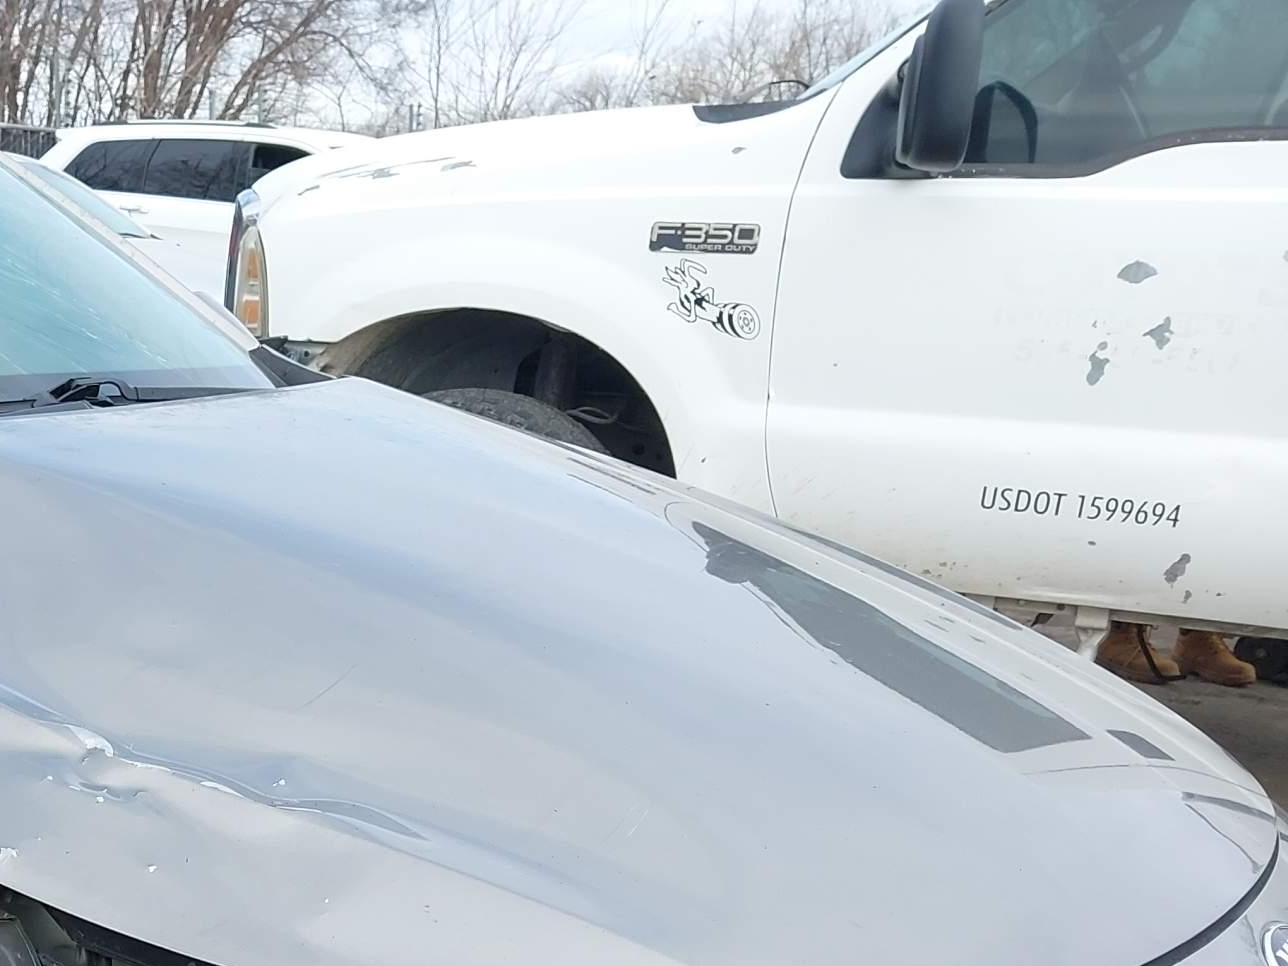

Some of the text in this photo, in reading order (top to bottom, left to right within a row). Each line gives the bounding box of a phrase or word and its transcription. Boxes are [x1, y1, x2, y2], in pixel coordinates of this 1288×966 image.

[684, 243, 756, 252] SUPER DUTY
[980, 486, 1182, 528] USDOT 1599694
